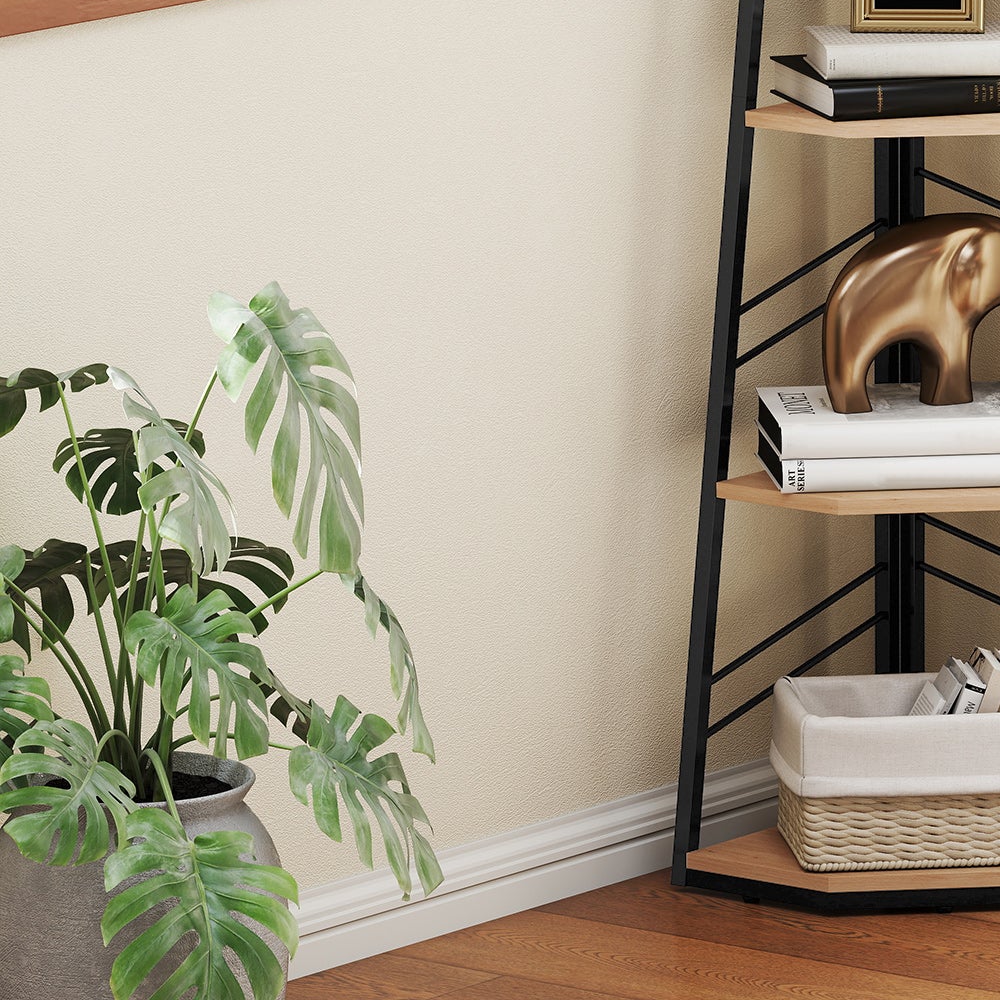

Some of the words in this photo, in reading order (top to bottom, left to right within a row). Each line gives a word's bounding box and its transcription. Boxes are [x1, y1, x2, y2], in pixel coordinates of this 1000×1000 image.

[777, 392, 815, 415] MONET
[788, 469, 796, 487] ART
[797, 460, 805, 491] SERIES
